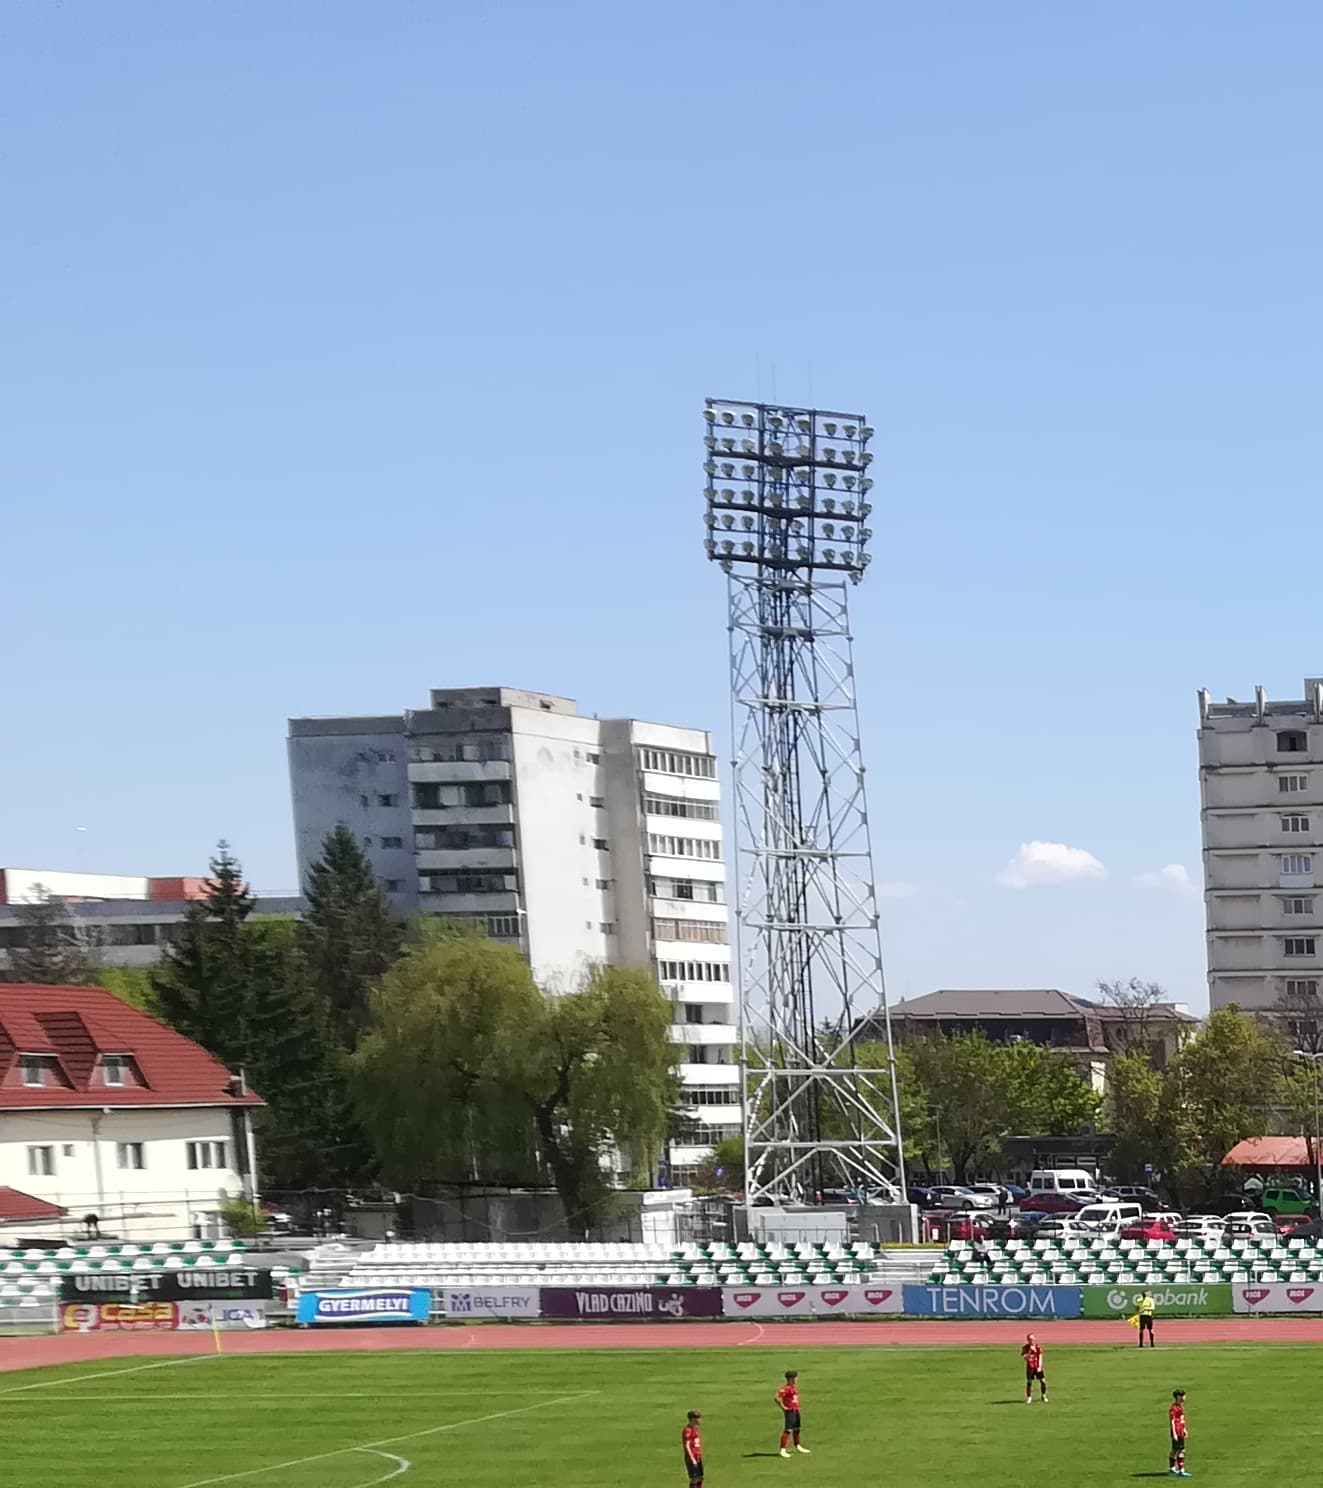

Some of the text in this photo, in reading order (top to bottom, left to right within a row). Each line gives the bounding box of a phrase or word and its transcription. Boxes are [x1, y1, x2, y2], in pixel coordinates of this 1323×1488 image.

[75, 1272, 258, 1291] UNIBET UNIBET
[319, 1297, 408, 1313] GYERMELYI
[474, 1296, 530, 1308] BELFRY
[576, 1292, 653, 1314] VLAD CAZINO
[926, 1288, 1055, 1313] TENROM
